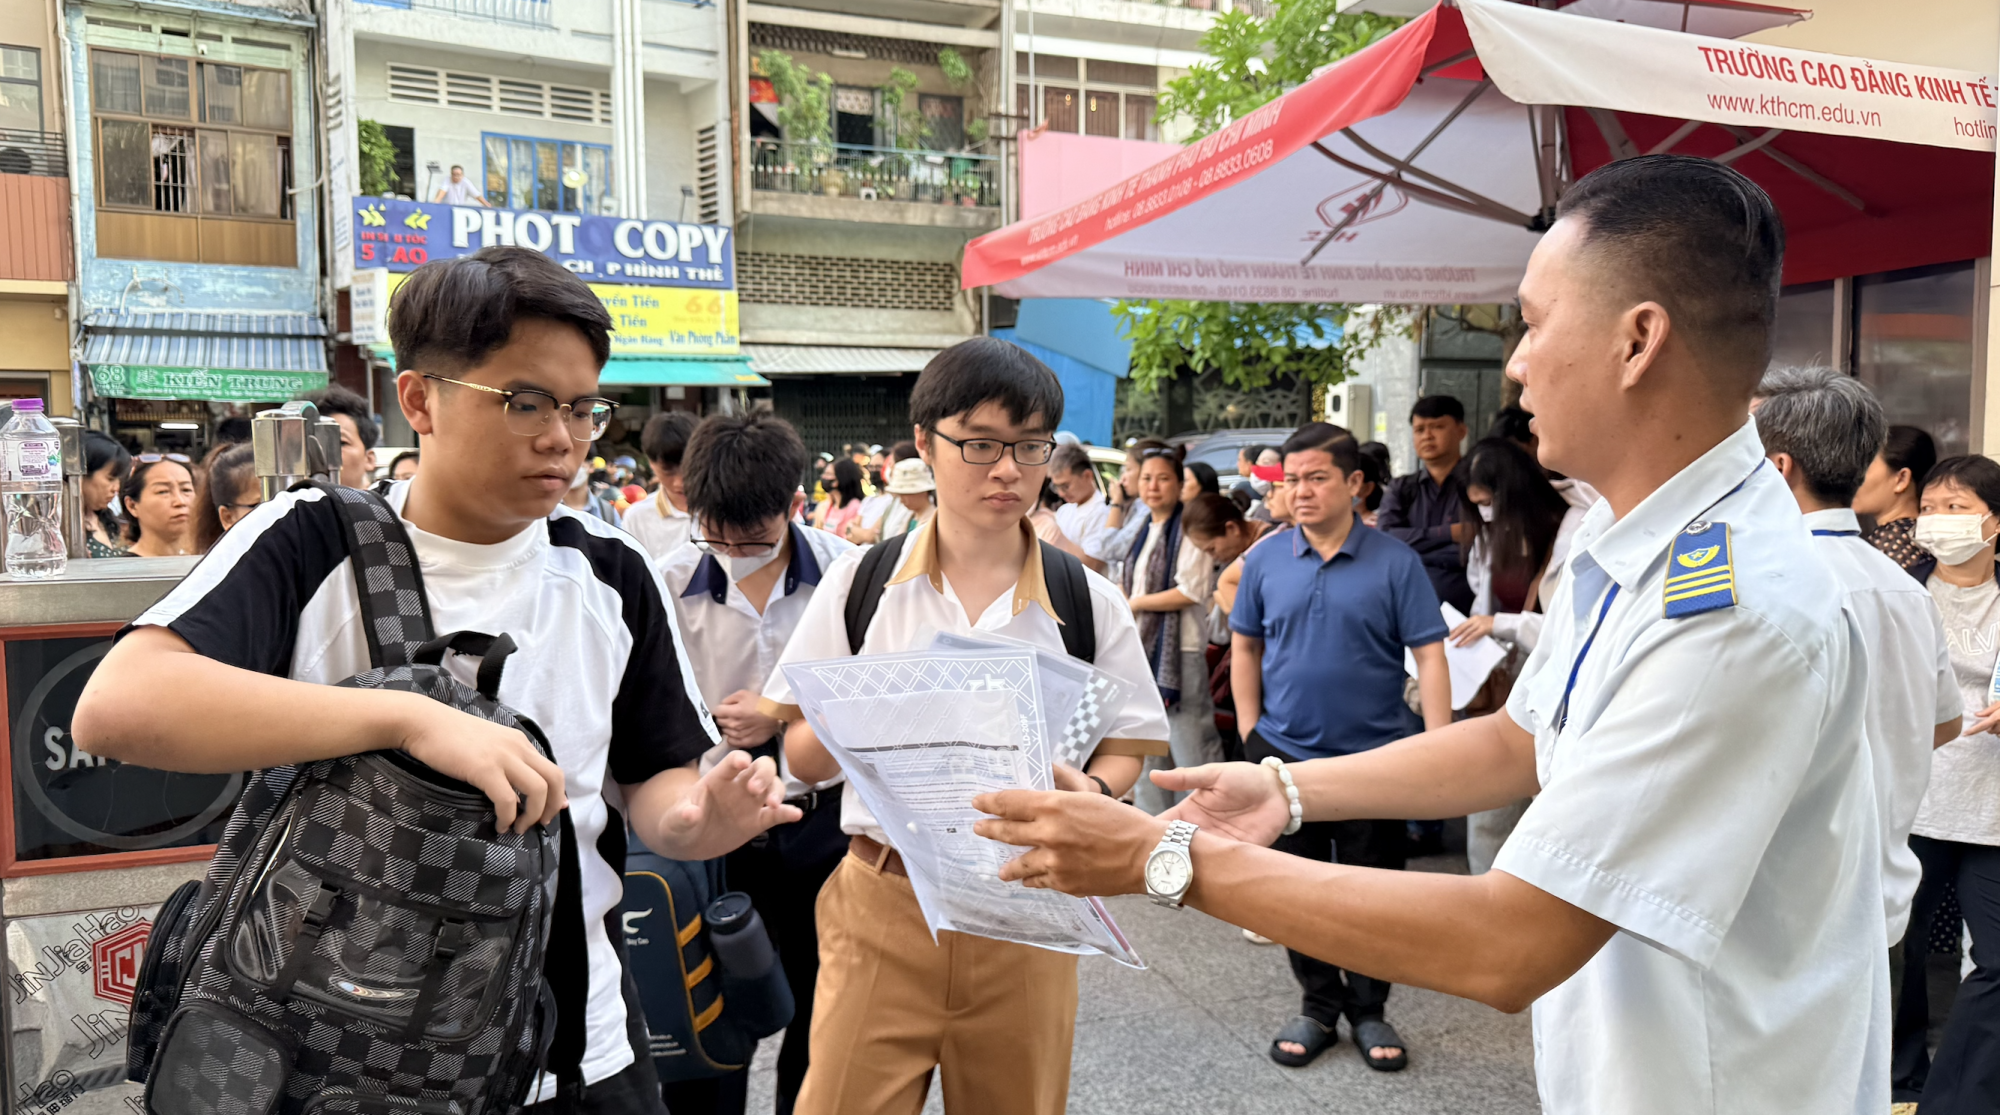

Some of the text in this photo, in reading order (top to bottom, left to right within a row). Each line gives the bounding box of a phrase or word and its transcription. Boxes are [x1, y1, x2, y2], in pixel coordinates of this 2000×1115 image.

[1698, 46, 1997, 108] TRƯỜNG CAO ĐẲNG KINH TẾ
[1707, 93, 1881, 127] www.kthcm.edu.vn
[1954, 117, 1997, 139] hotlin
[614, 219, 729, 265] COPY
[362, 243, 428, 265] 5 AO
[624, 259, 680, 279] HÌNH
[95, 364, 125, 384] 68
[227, 374, 303, 391] TRUNG
